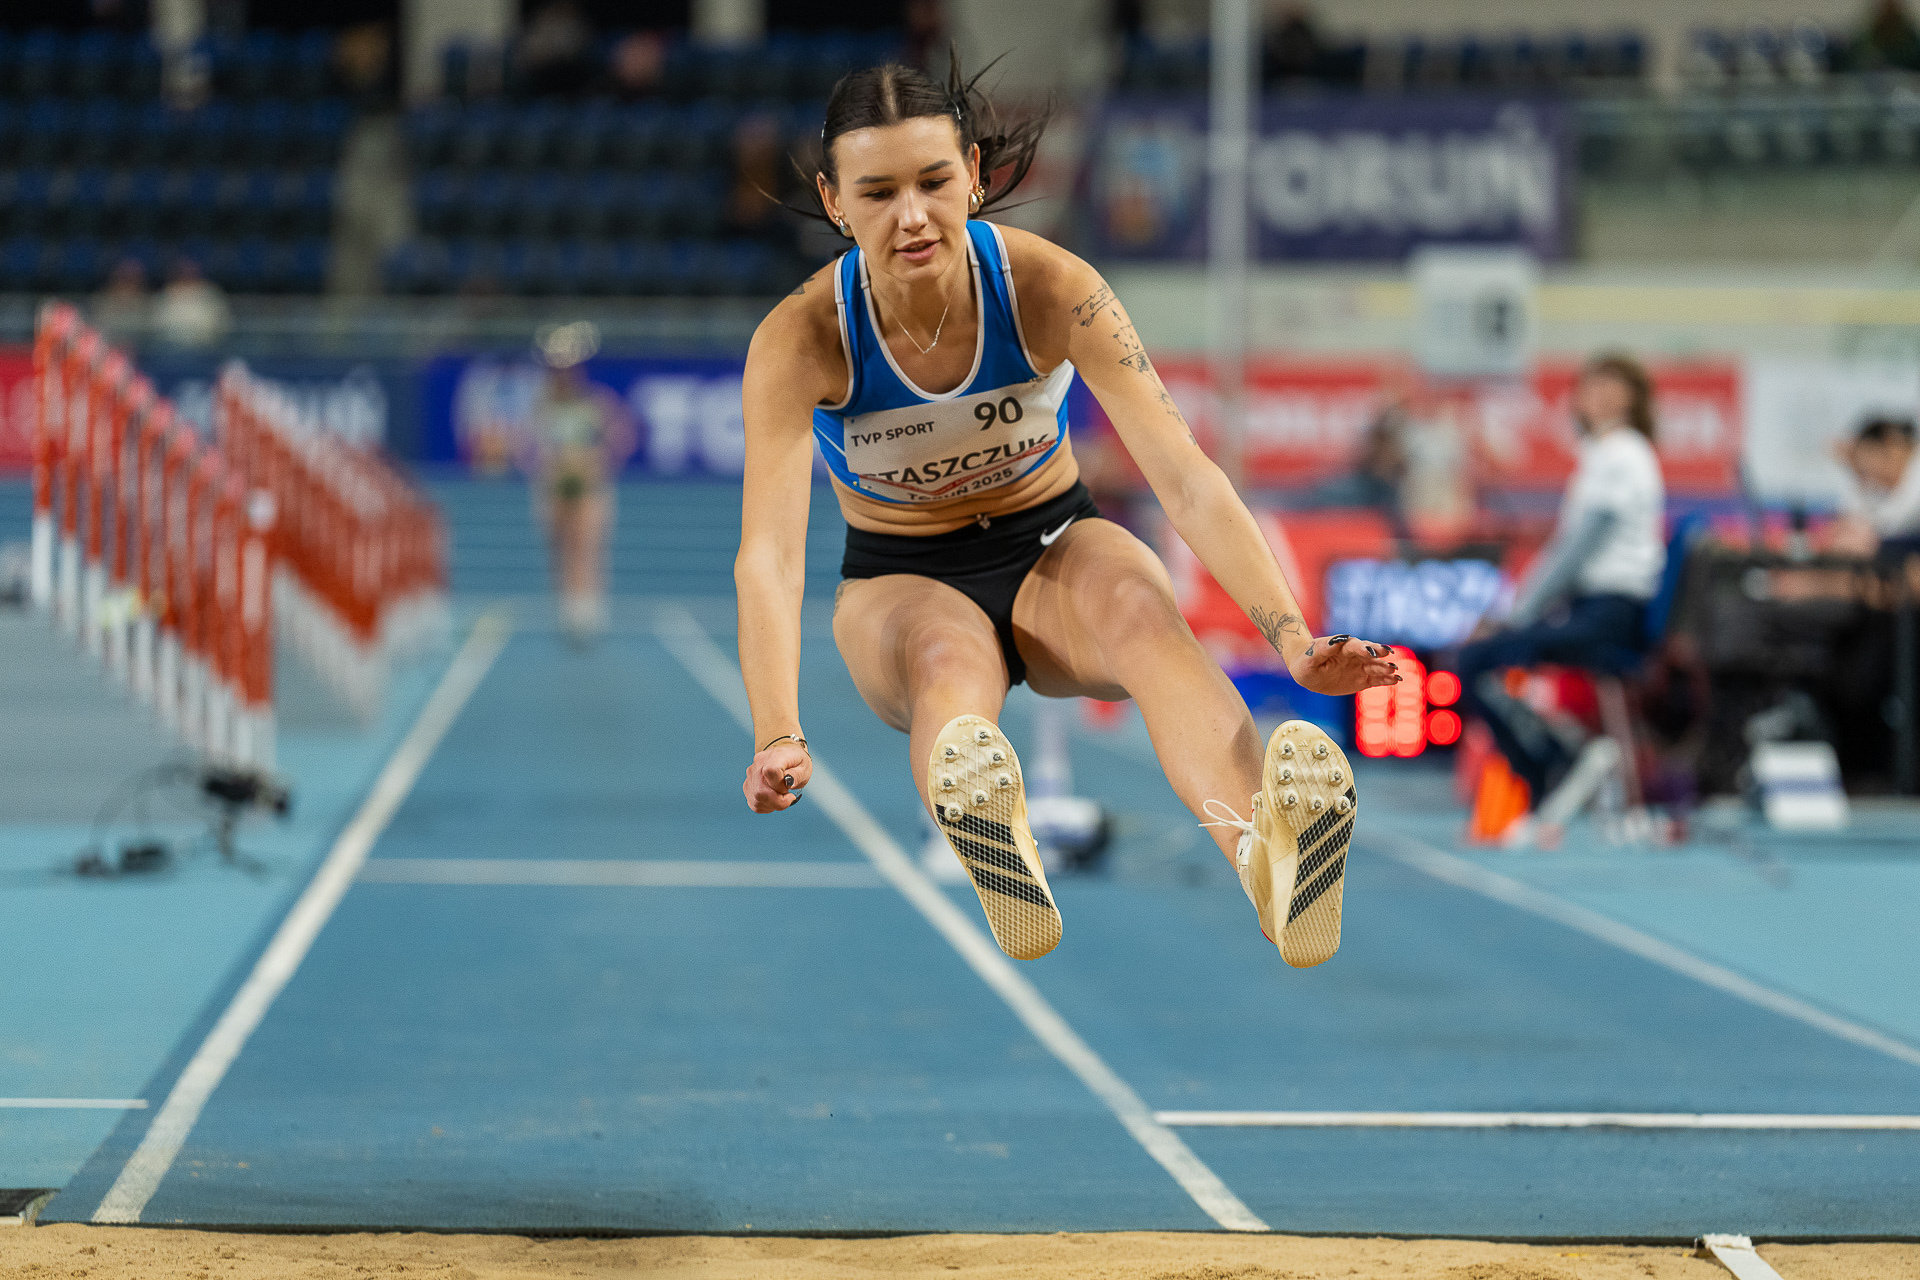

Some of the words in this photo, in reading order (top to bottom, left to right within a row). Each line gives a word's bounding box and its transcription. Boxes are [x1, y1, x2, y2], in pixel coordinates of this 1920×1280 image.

[1208, 104, 1557, 238] ORUŃ
[974, 396, 1023, 431] 90
[851, 432, 882, 447] TVP
[886, 421, 935, 441] SPORT
[860, 433, 1049, 485] TASZCZUK
[972, 467, 1013, 489] 2025
